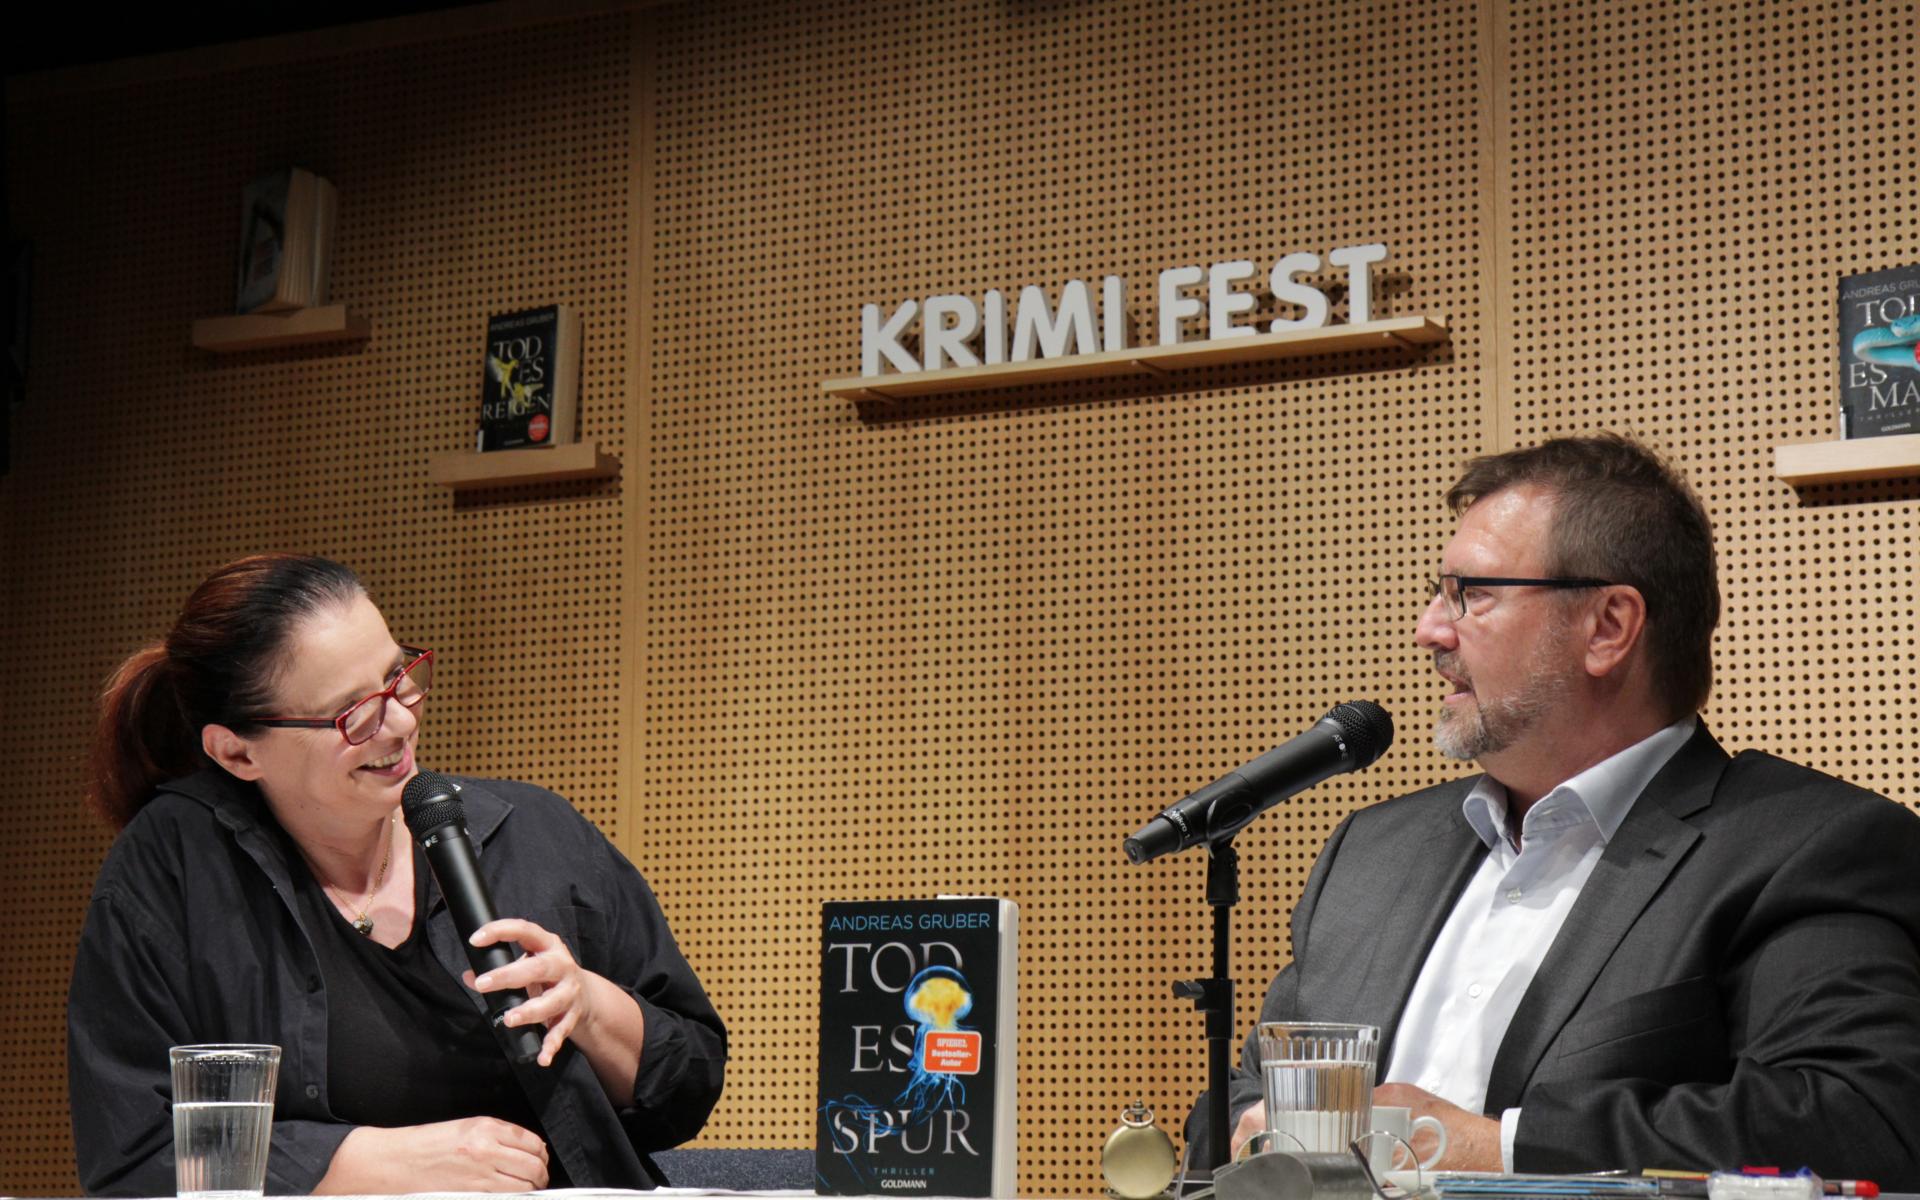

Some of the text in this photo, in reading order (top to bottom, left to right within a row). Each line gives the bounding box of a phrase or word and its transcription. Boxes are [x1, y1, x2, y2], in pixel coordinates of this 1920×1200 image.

[1843, 283, 1896, 300] ANDREAS
[862, 243, 1388, 377] KRIMI FEST
[493, 336, 542, 360] TOD
[1850, 361, 1888, 388] ES
[829, 913, 990, 931] ANDREAS GRUBER
[851, 1024, 915, 1073] ES
[832, 1109, 980, 1156] SPUR
[873, 1167, 935, 1176] THRILLER
[881, 1180, 927, 1189] GOLDMANN
